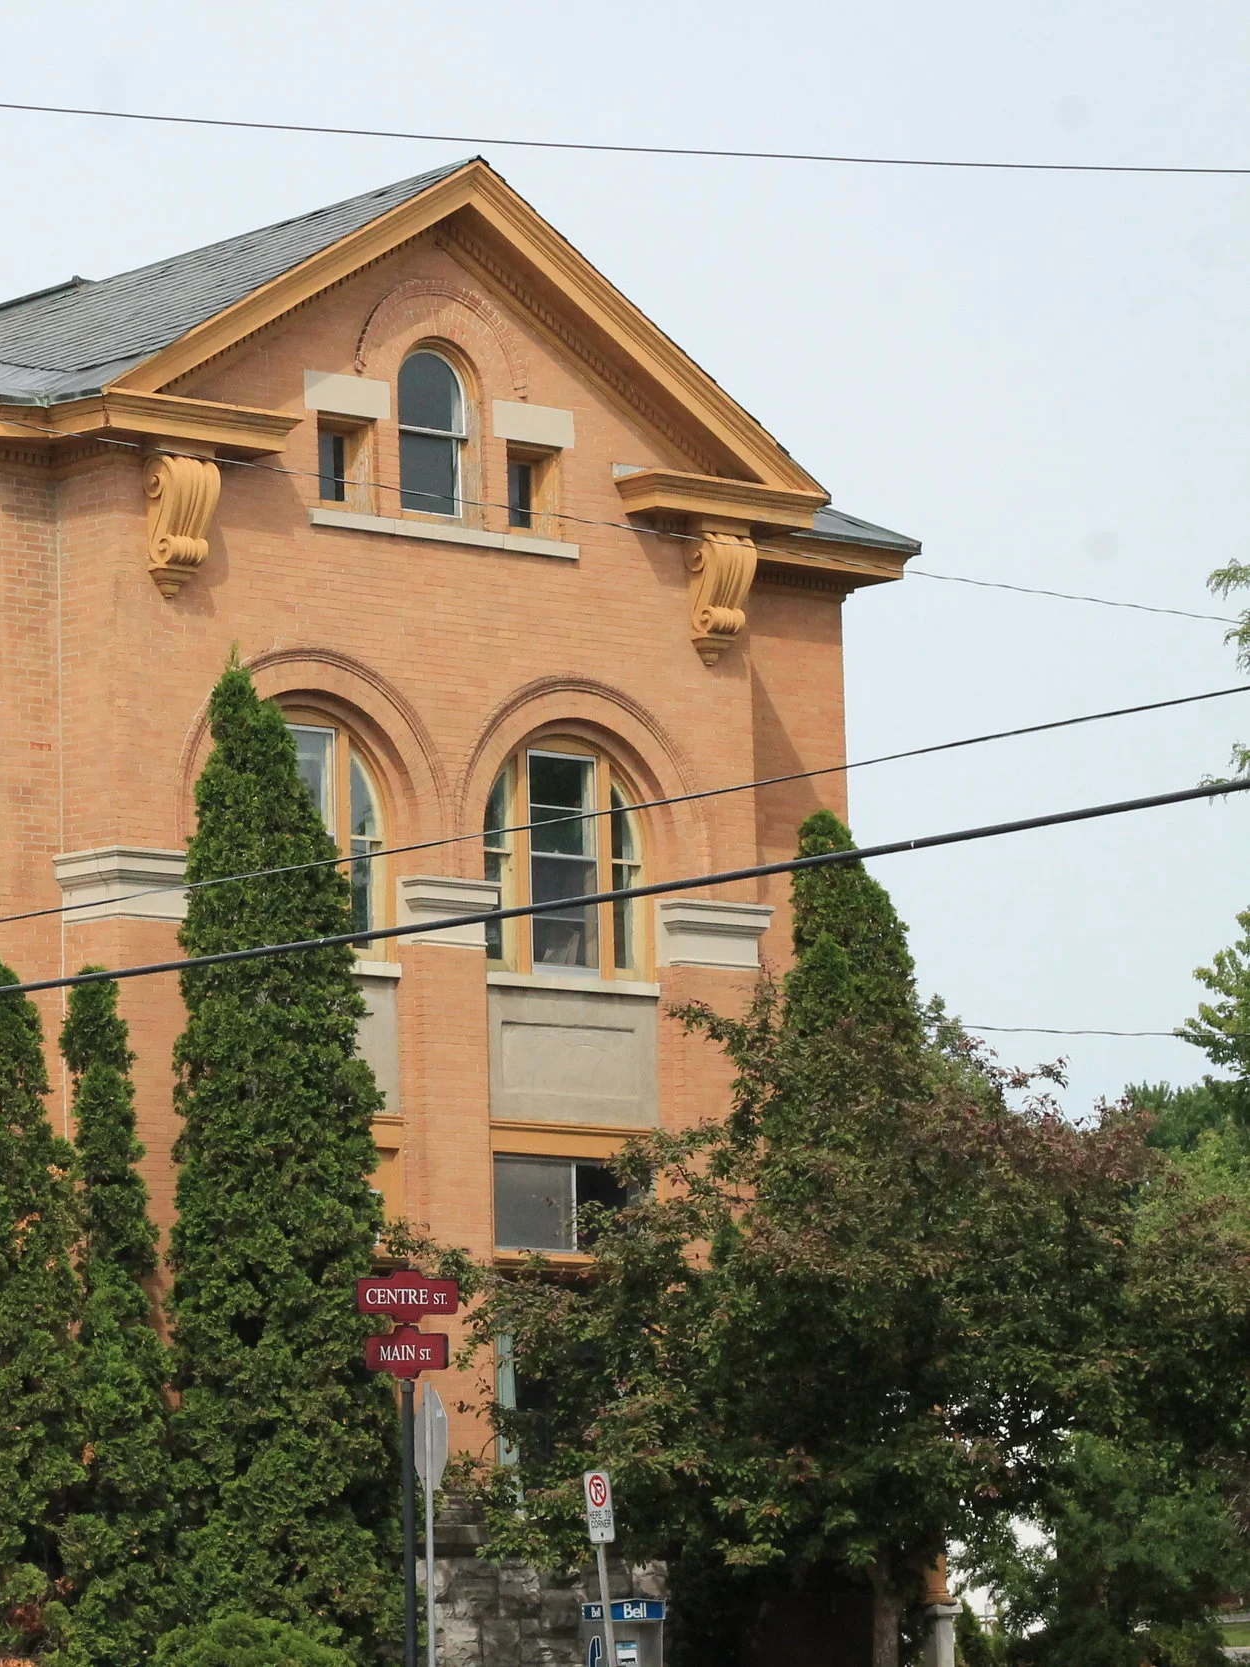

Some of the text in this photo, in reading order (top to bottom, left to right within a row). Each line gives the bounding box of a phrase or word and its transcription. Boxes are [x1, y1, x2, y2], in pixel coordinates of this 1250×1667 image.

[365, 1288, 448, 1305] CENTRE ST.
[380, 1344, 416, 1361] MAIN
[589, 1510, 612, 1519] HERE TO
[590, 1519, 612, 1528] CORNER
[591, 1606, 601, 1618] Bell
[623, 1602, 647, 1619] Bell
